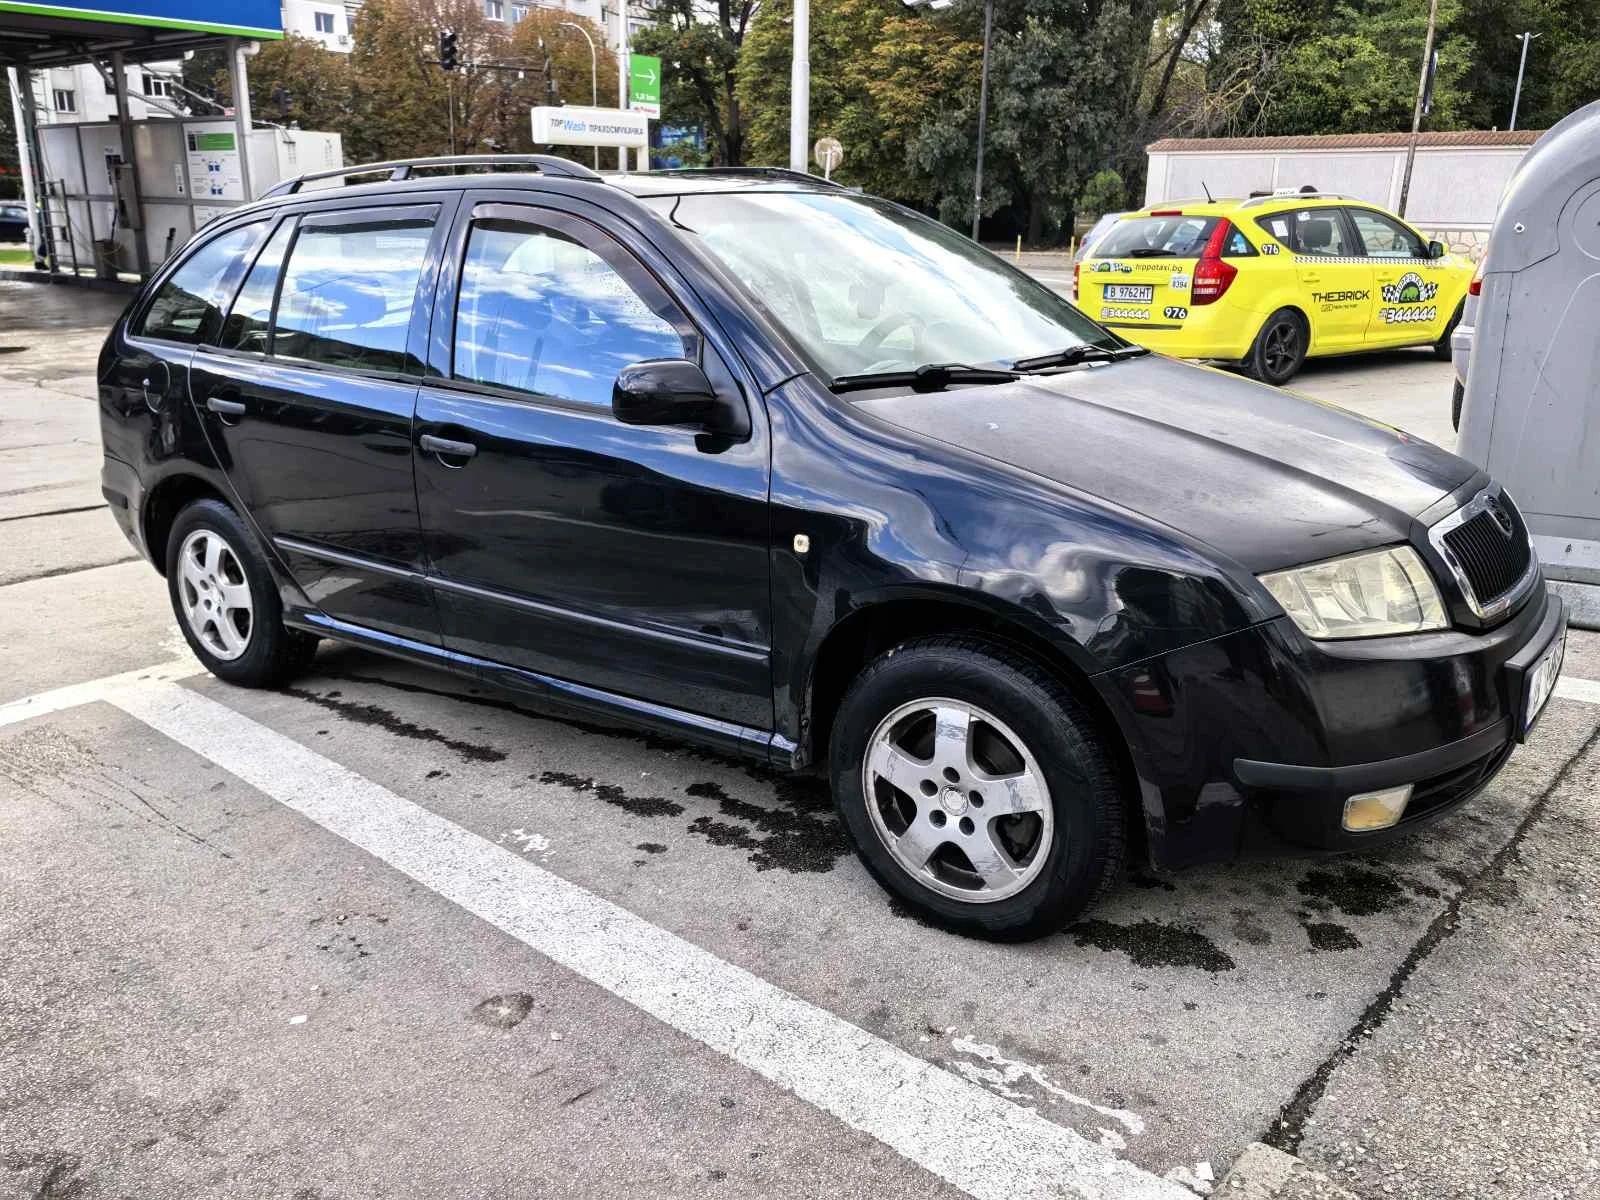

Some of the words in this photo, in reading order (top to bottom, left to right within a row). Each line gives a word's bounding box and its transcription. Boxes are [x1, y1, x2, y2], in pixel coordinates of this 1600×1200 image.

[564, 119, 586, 133] Wash
[1262, 244, 1279, 254] 976
[1135, 263, 1183, 273] hippotaxi.bg
[1108, 307, 1150, 319] 344444
[1165, 307, 1186, 319] 976
[1386, 306, 1437, 324] 344444
